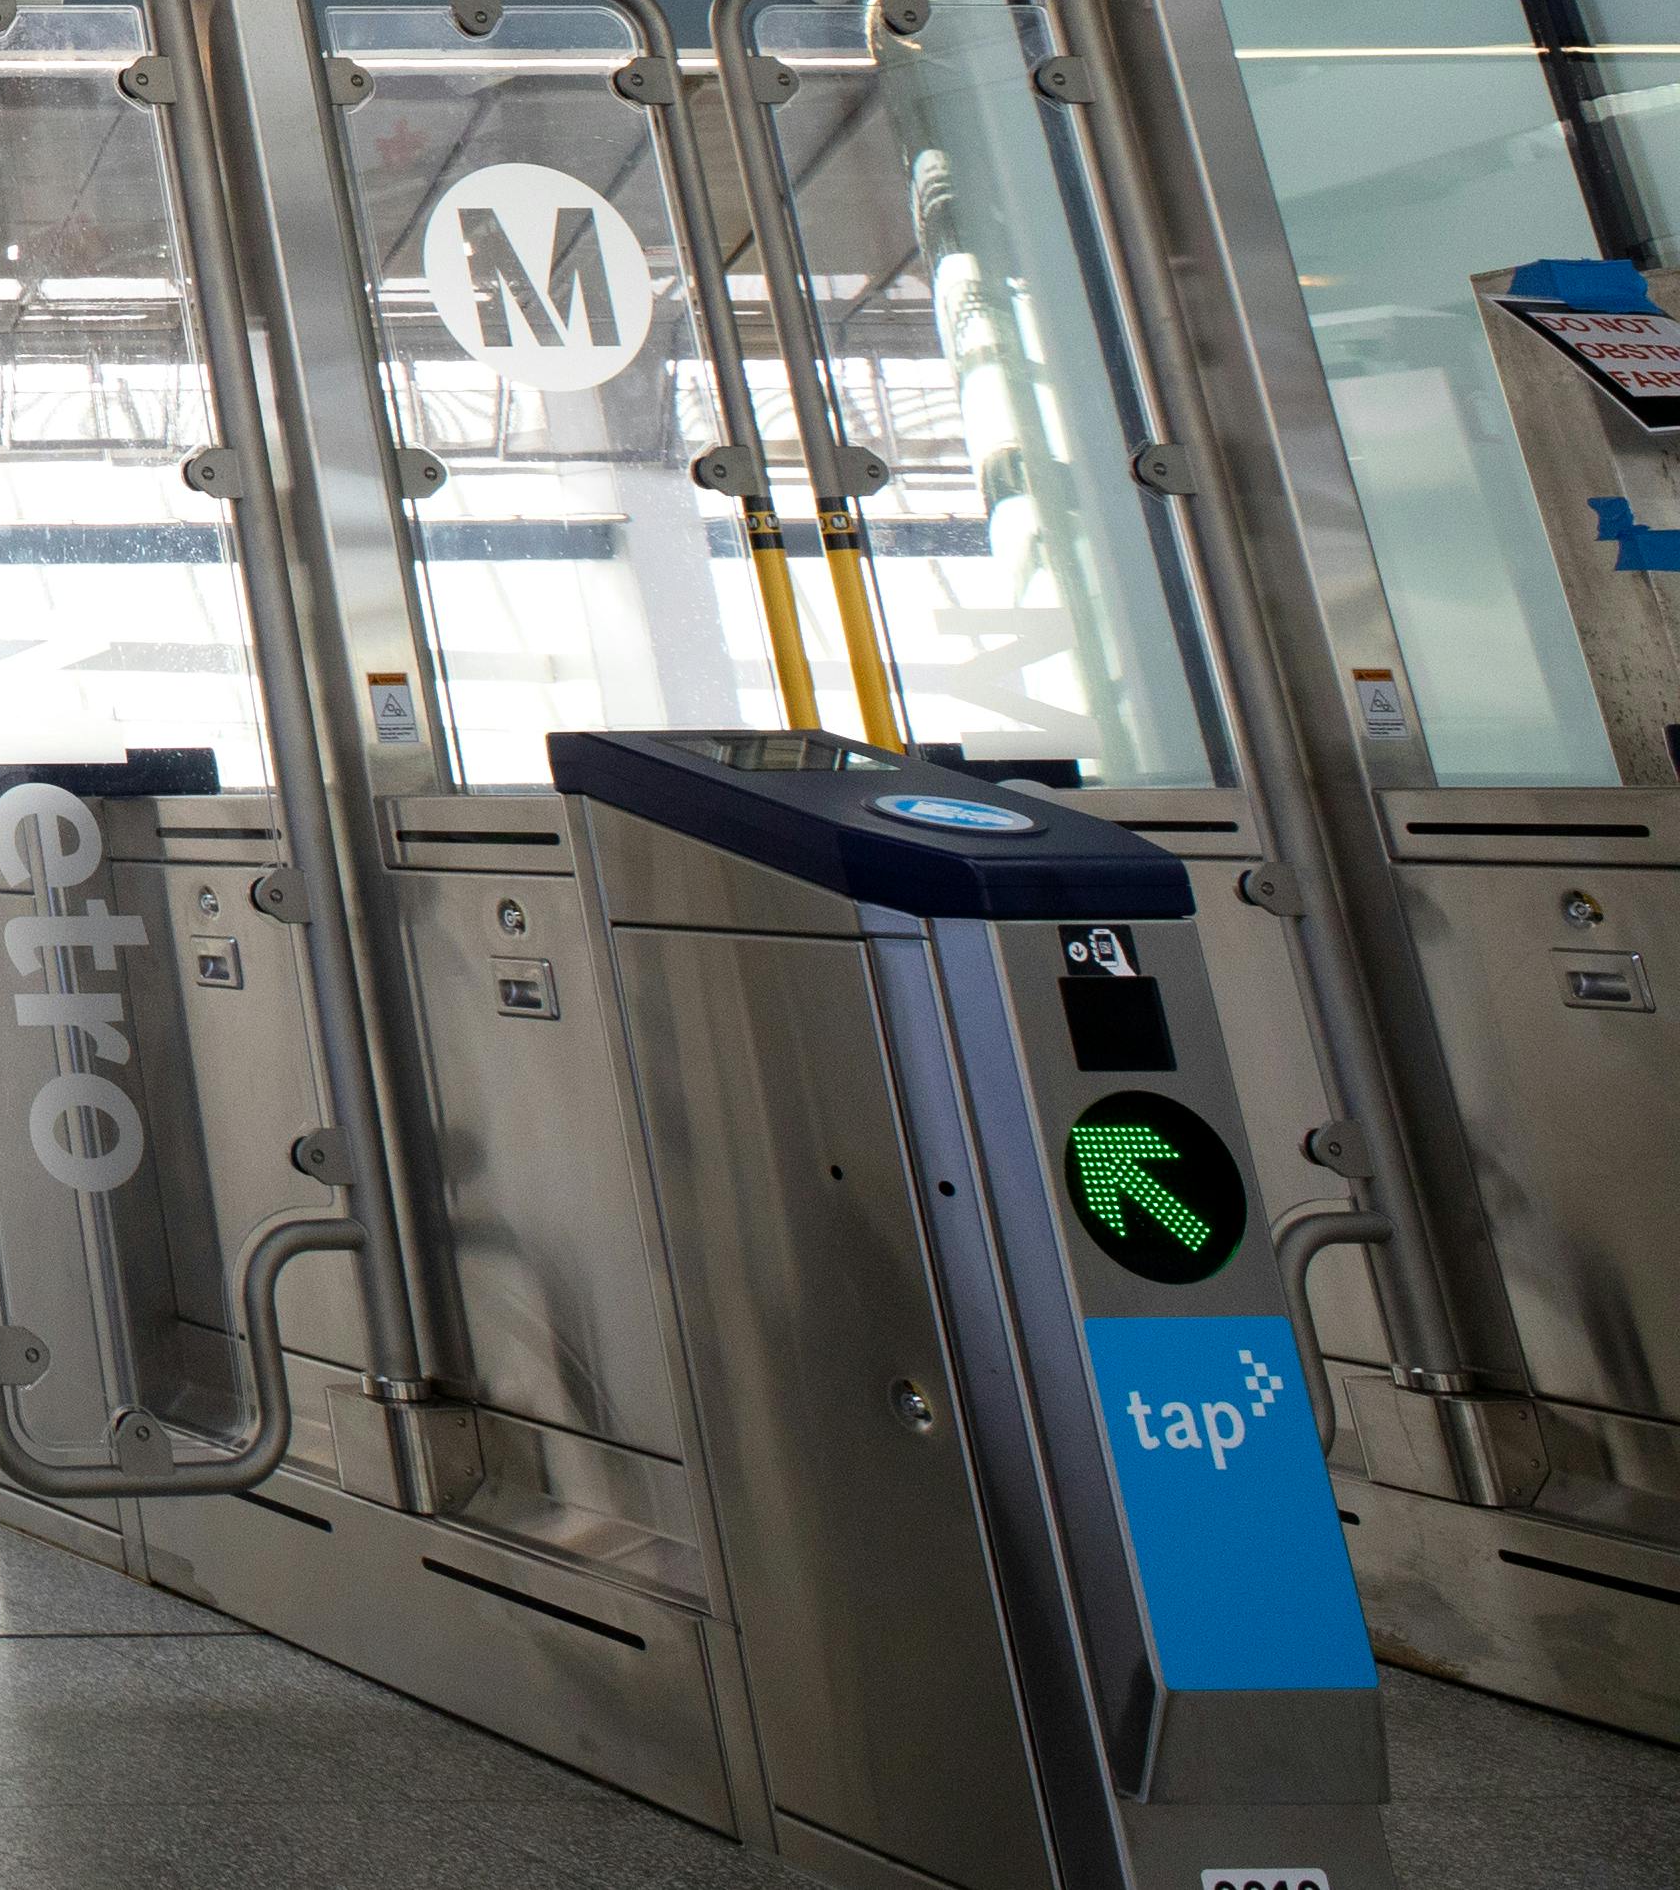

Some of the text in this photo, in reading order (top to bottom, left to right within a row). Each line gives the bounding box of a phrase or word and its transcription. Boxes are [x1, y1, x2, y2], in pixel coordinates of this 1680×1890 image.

[1536, 316, 1661, 335] DO NOT
[1575, 342, 1680, 361] OBSTR
[1127, 1391, 1246, 1470] tap
